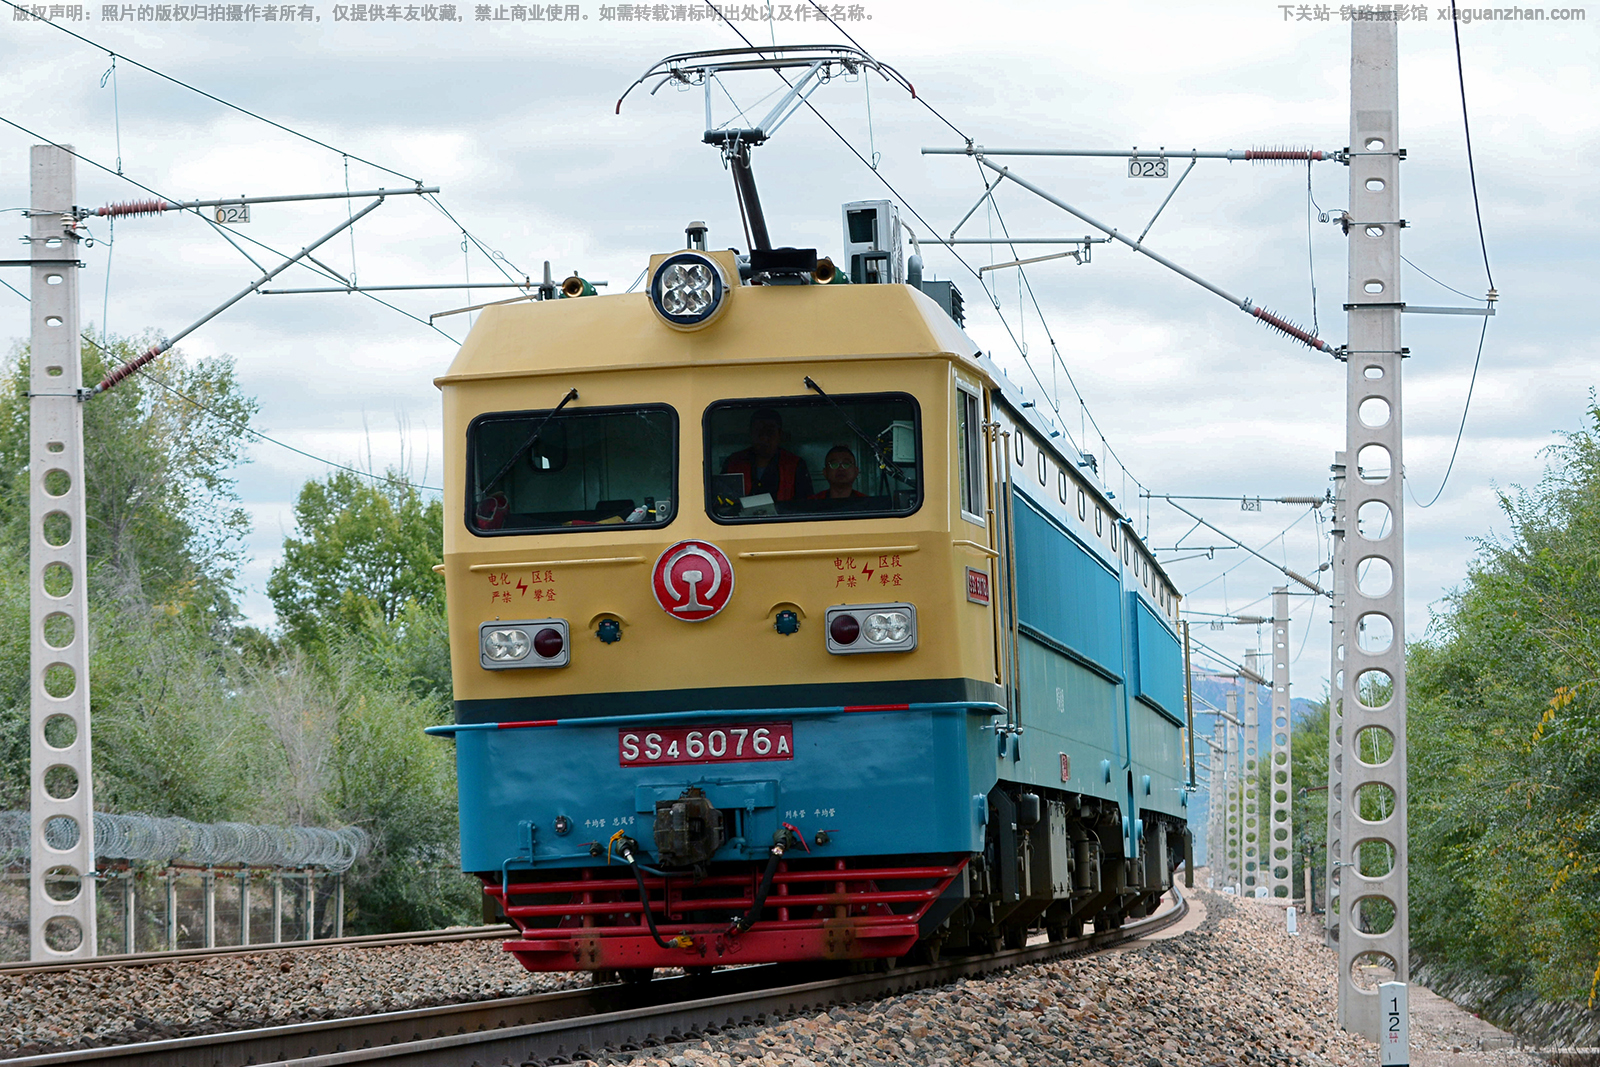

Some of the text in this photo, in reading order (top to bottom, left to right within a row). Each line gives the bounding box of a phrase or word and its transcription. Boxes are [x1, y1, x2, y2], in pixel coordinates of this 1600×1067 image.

[1130, 161, 1166, 176] 023
[216, 208, 248, 223] 024
[1241, 502, 1260, 511] 021
[834, 555, 902, 570] 电化 区段
[488, 570, 555, 586] 电化 区段
[835, 573, 903, 588] 严禁 攀登
[491, 588, 556, 604] 严禁 攀登
[622, 728, 790, 761] SS46076A
[814, 808, 836, 818] 平均管
[584, 818, 606, 828] 平均管
